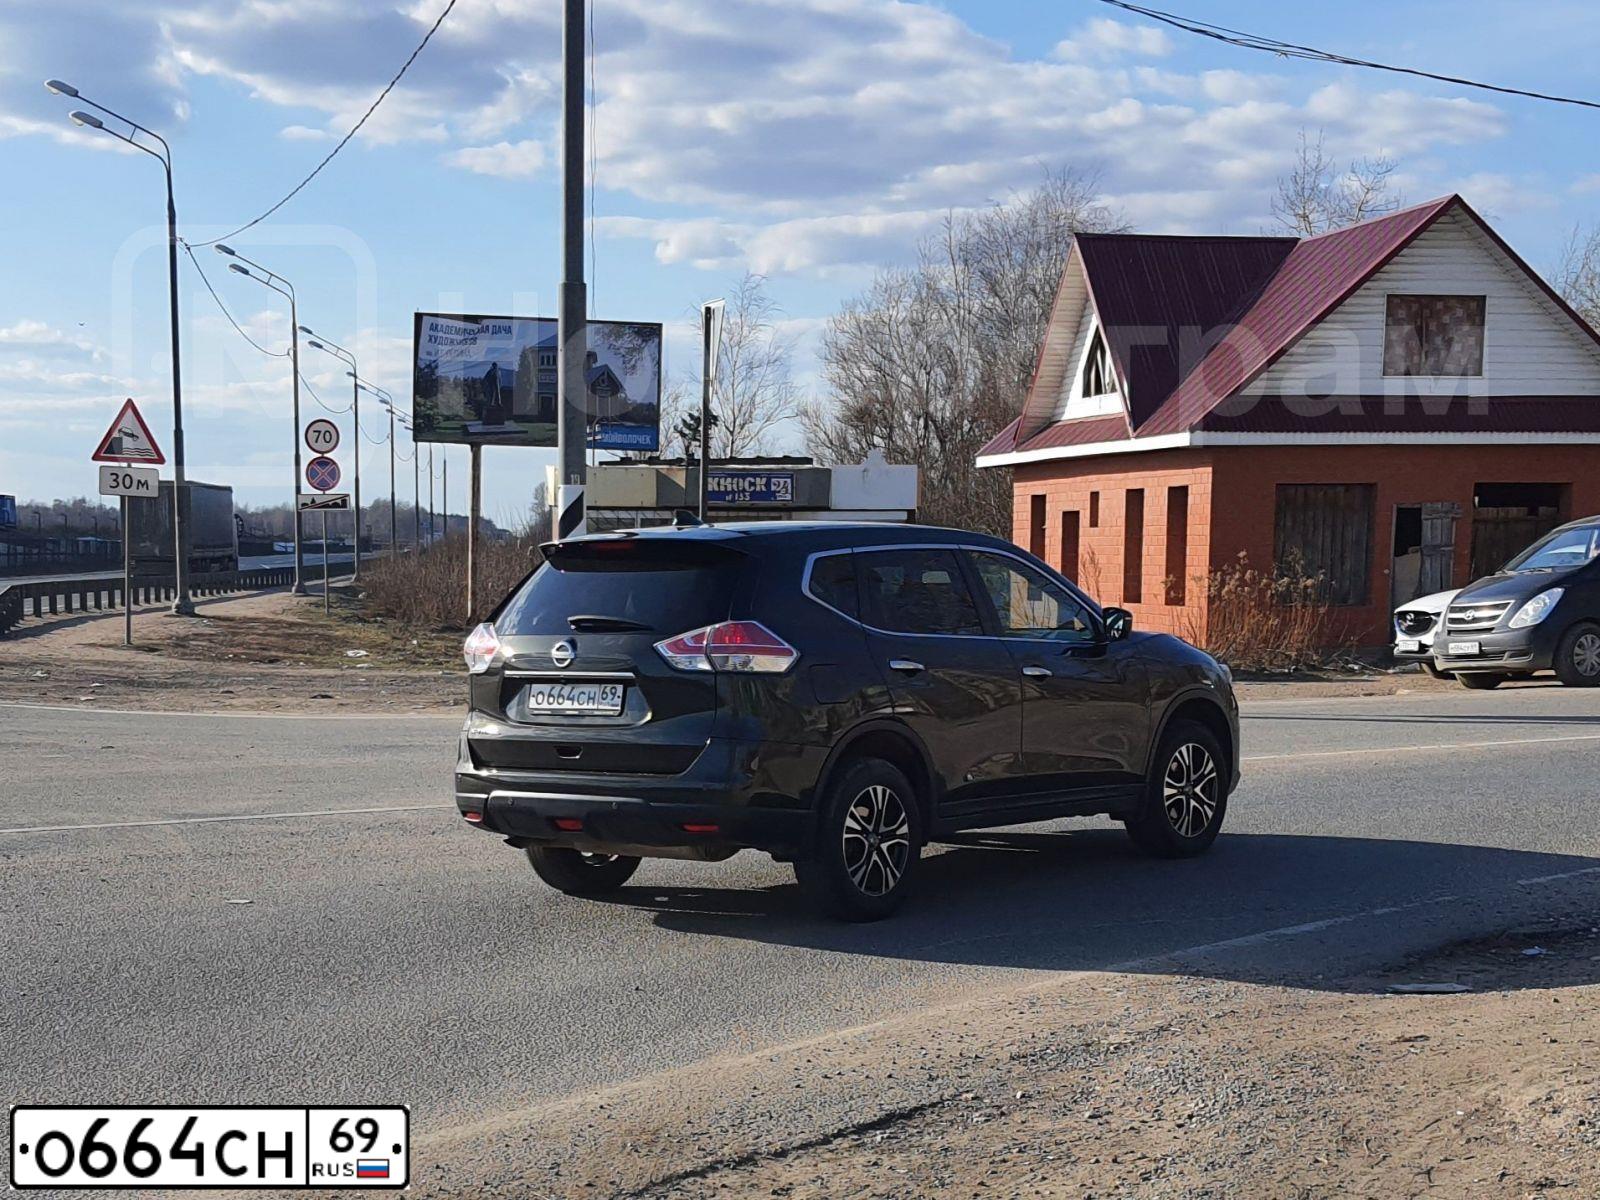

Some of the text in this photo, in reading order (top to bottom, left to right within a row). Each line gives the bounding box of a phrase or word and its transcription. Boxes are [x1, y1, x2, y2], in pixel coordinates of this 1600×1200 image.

[490, 324, 513, 336] ДАЧА
[313, 430, 333, 444] 70
[707, 477, 767, 491] КИОСК
